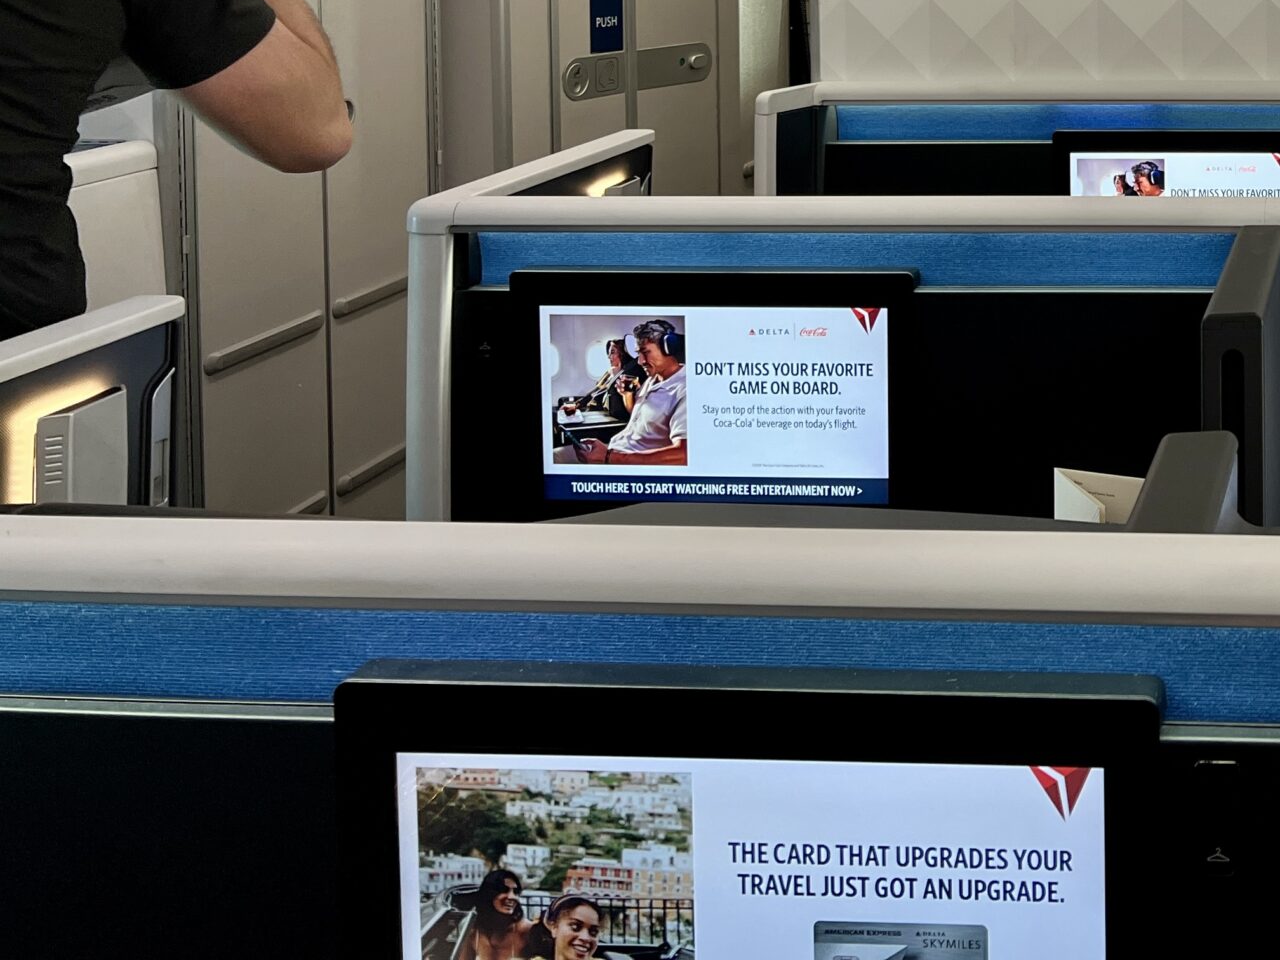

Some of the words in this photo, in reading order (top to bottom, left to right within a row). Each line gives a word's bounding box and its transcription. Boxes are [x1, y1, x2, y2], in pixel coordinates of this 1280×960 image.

[596, 16, 617, 28] PUSH
[1171, 189, 1196, 197] DON'T
[1199, 189, 1219, 197] MISS
[1221, 189, 1244, 197] YOUR
[695, 362, 735, 376] DON'T
[737, 363, 769, 376] MISS
[773, 363, 808, 376] YOUR
[812, 363, 873, 376] FAVORITE
[729, 381, 767, 394] GAME
[771, 381, 789, 394] ON
[793, 382, 841, 395] BOARD.
[702, 405, 718, 415] Stay
[733, 406, 745, 415] top
[747, 405, 755, 414] of
[757, 406, 769, 414] the
[771, 406, 795, 414] action
[797, 406, 814, 414] with
[816, 408, 833, 416] your
[835, 406, 866, 415] favorite
[757, 419, 791, 430] beverage
[805, 419, 832, 430] today's
[834, 419, 857, 430] flight.
[571, 482, 604, 493] TOUCH
[605, 482, 629, 493] HERE
[631, 483, 644, 494] TO
[645, 483, 674, 494] START
[675, 484, 725, 494] WATCHING
[727, 484, 749, 495] FREE
[751, 484, 830, 496] ENTERTAINMENT
[831, 486, 855, 496] NOW
[728, 841, 769, 864] THE
[773, 843, 831, 865] CARD
[835, 844, 890, 867] THAT
[896, 846, 1008, 869] UPGRADES
[1013, 849, 1073, 871] YOUR
[737, 874, 816, 897] TRAVEL
[820, 876, 870, 898] JUST
[874, 877, 916, 899] GOT
[923, 879, 952, 900] AN
[958, 880, 1065, 903] UPGRADE.
[922, 939, 981, 949] SKYMILES
